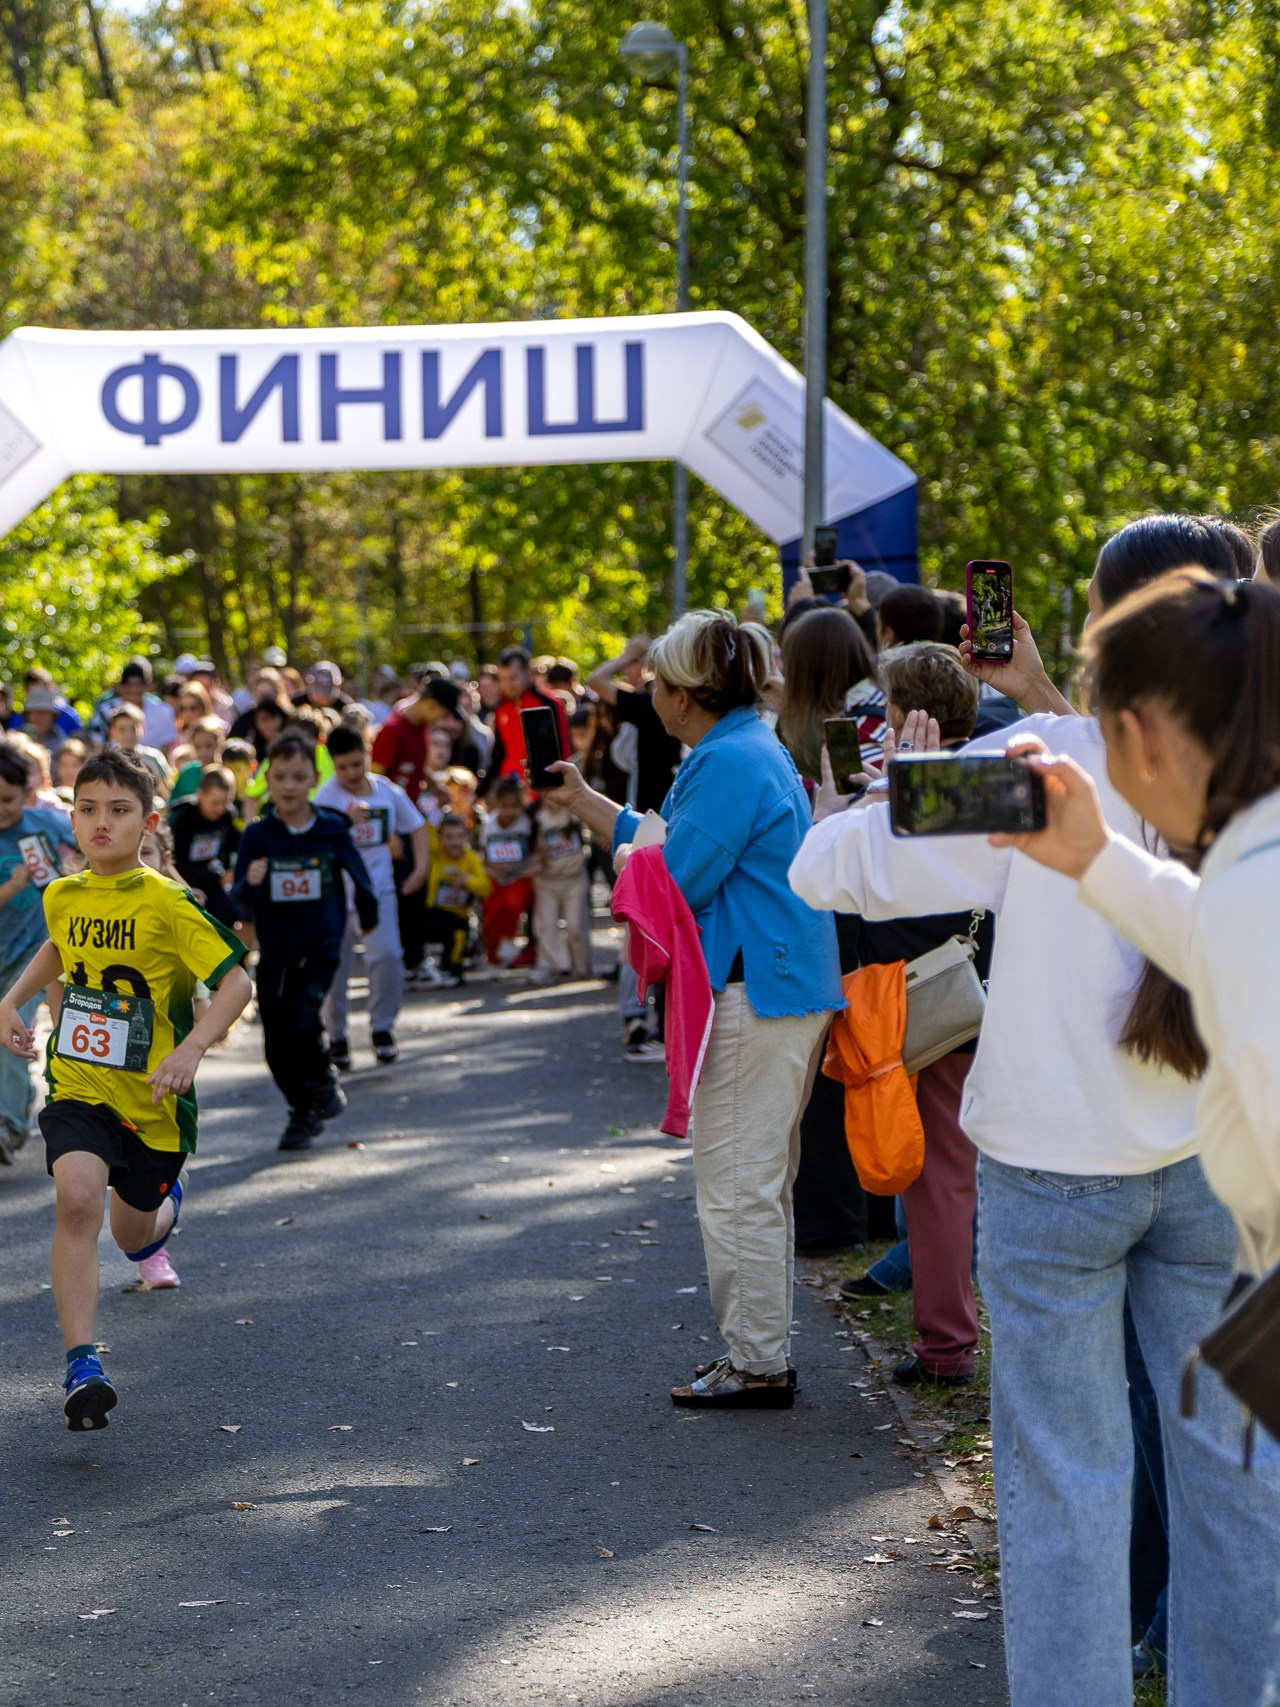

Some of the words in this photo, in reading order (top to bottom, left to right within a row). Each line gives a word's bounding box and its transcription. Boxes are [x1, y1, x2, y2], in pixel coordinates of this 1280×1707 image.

[101, 341, 644, 445] ФИНИШ
[23, 842, 49, 881] 100
[282, 879, 311, 898] 94
[67, 916, 136, 951] КУЗИН
[69, 992, 76, 1003] 5
[74, 998, 102, 1011] городов
[71, 1024, 111, 1058] 63
